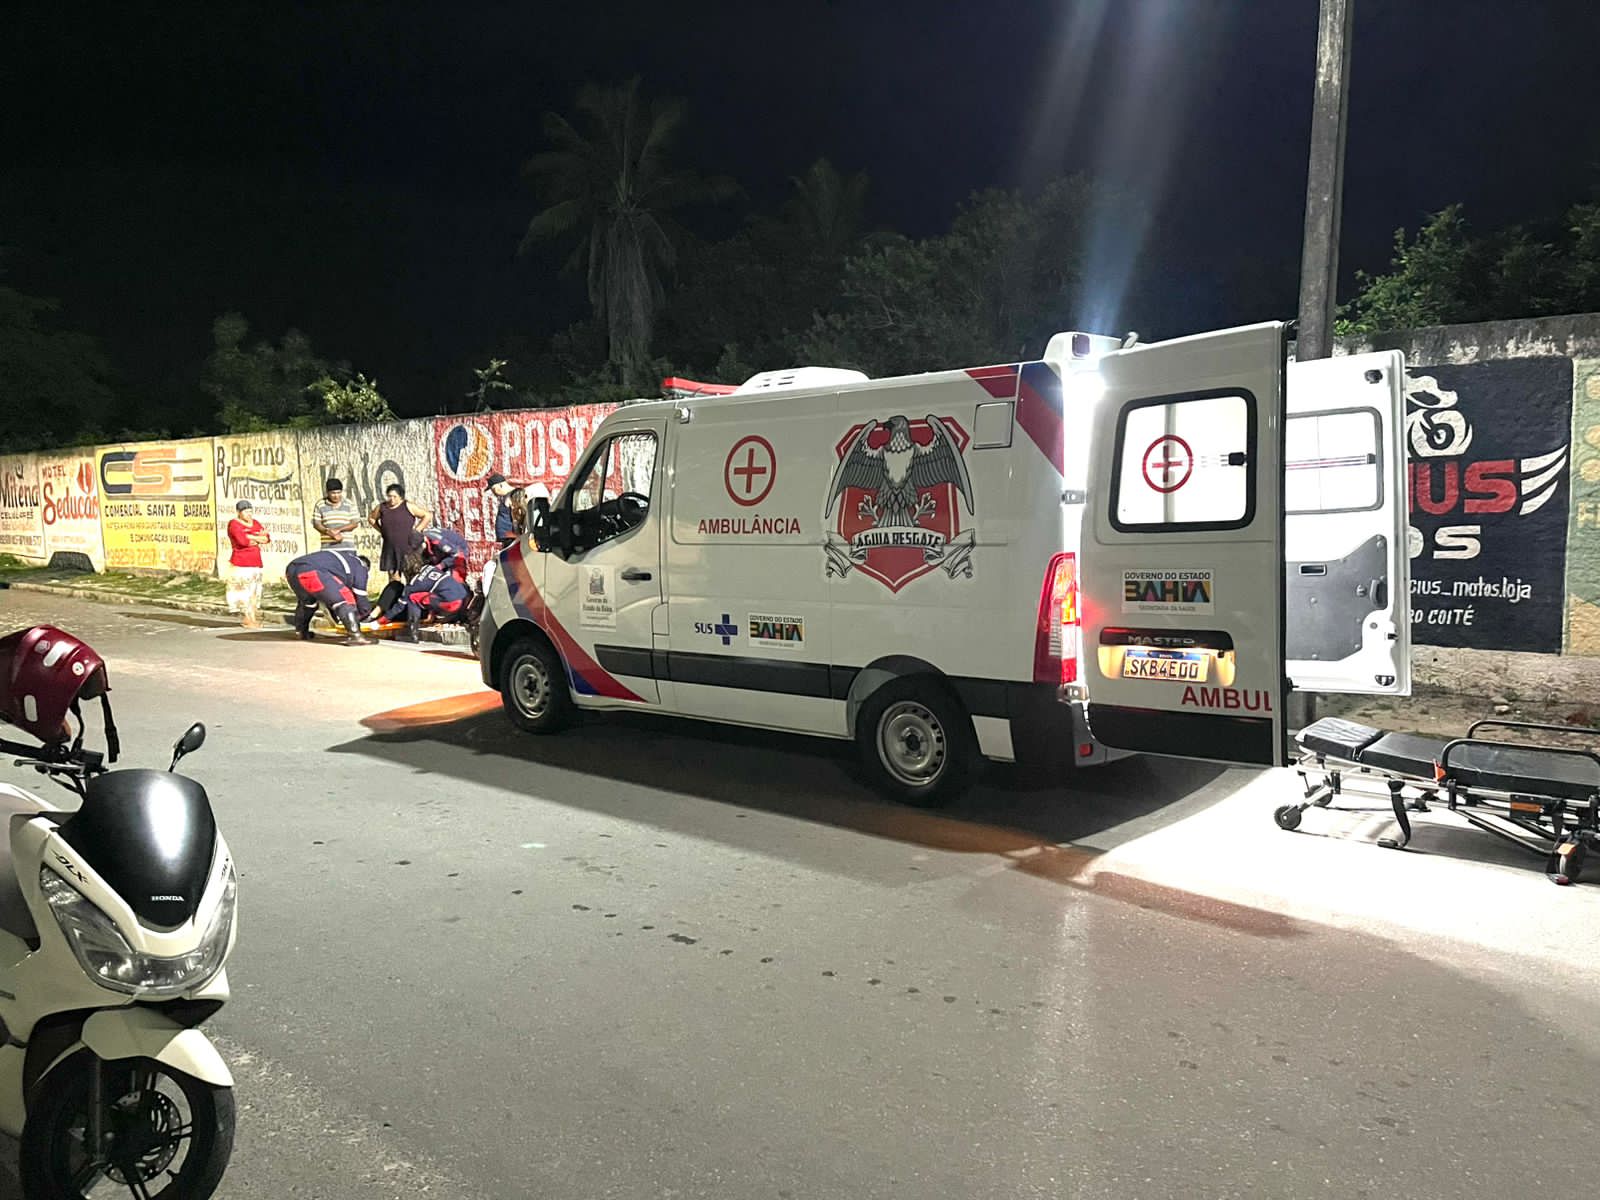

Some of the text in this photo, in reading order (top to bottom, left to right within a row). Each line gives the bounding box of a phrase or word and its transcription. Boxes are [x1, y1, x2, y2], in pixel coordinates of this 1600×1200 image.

[231, 443, 286, 467] Bruno
[146, 504, 176, 517] SANTA
[698, 515, 801, 535] AMBULÂNCIA
[892, 531, 941, 548] RESGATE
[1124, 571, 1211, 580] GOVERNO DO ESTADO
[1125, 581, 1211, 603] BAHIA
[1427, 604, 1475, 626] COITÉ
[694, 623, 713, 633] SUS
[750, 621, 803, 642] BAHIA
[1181, 686, 1273, 712] AMBUL
